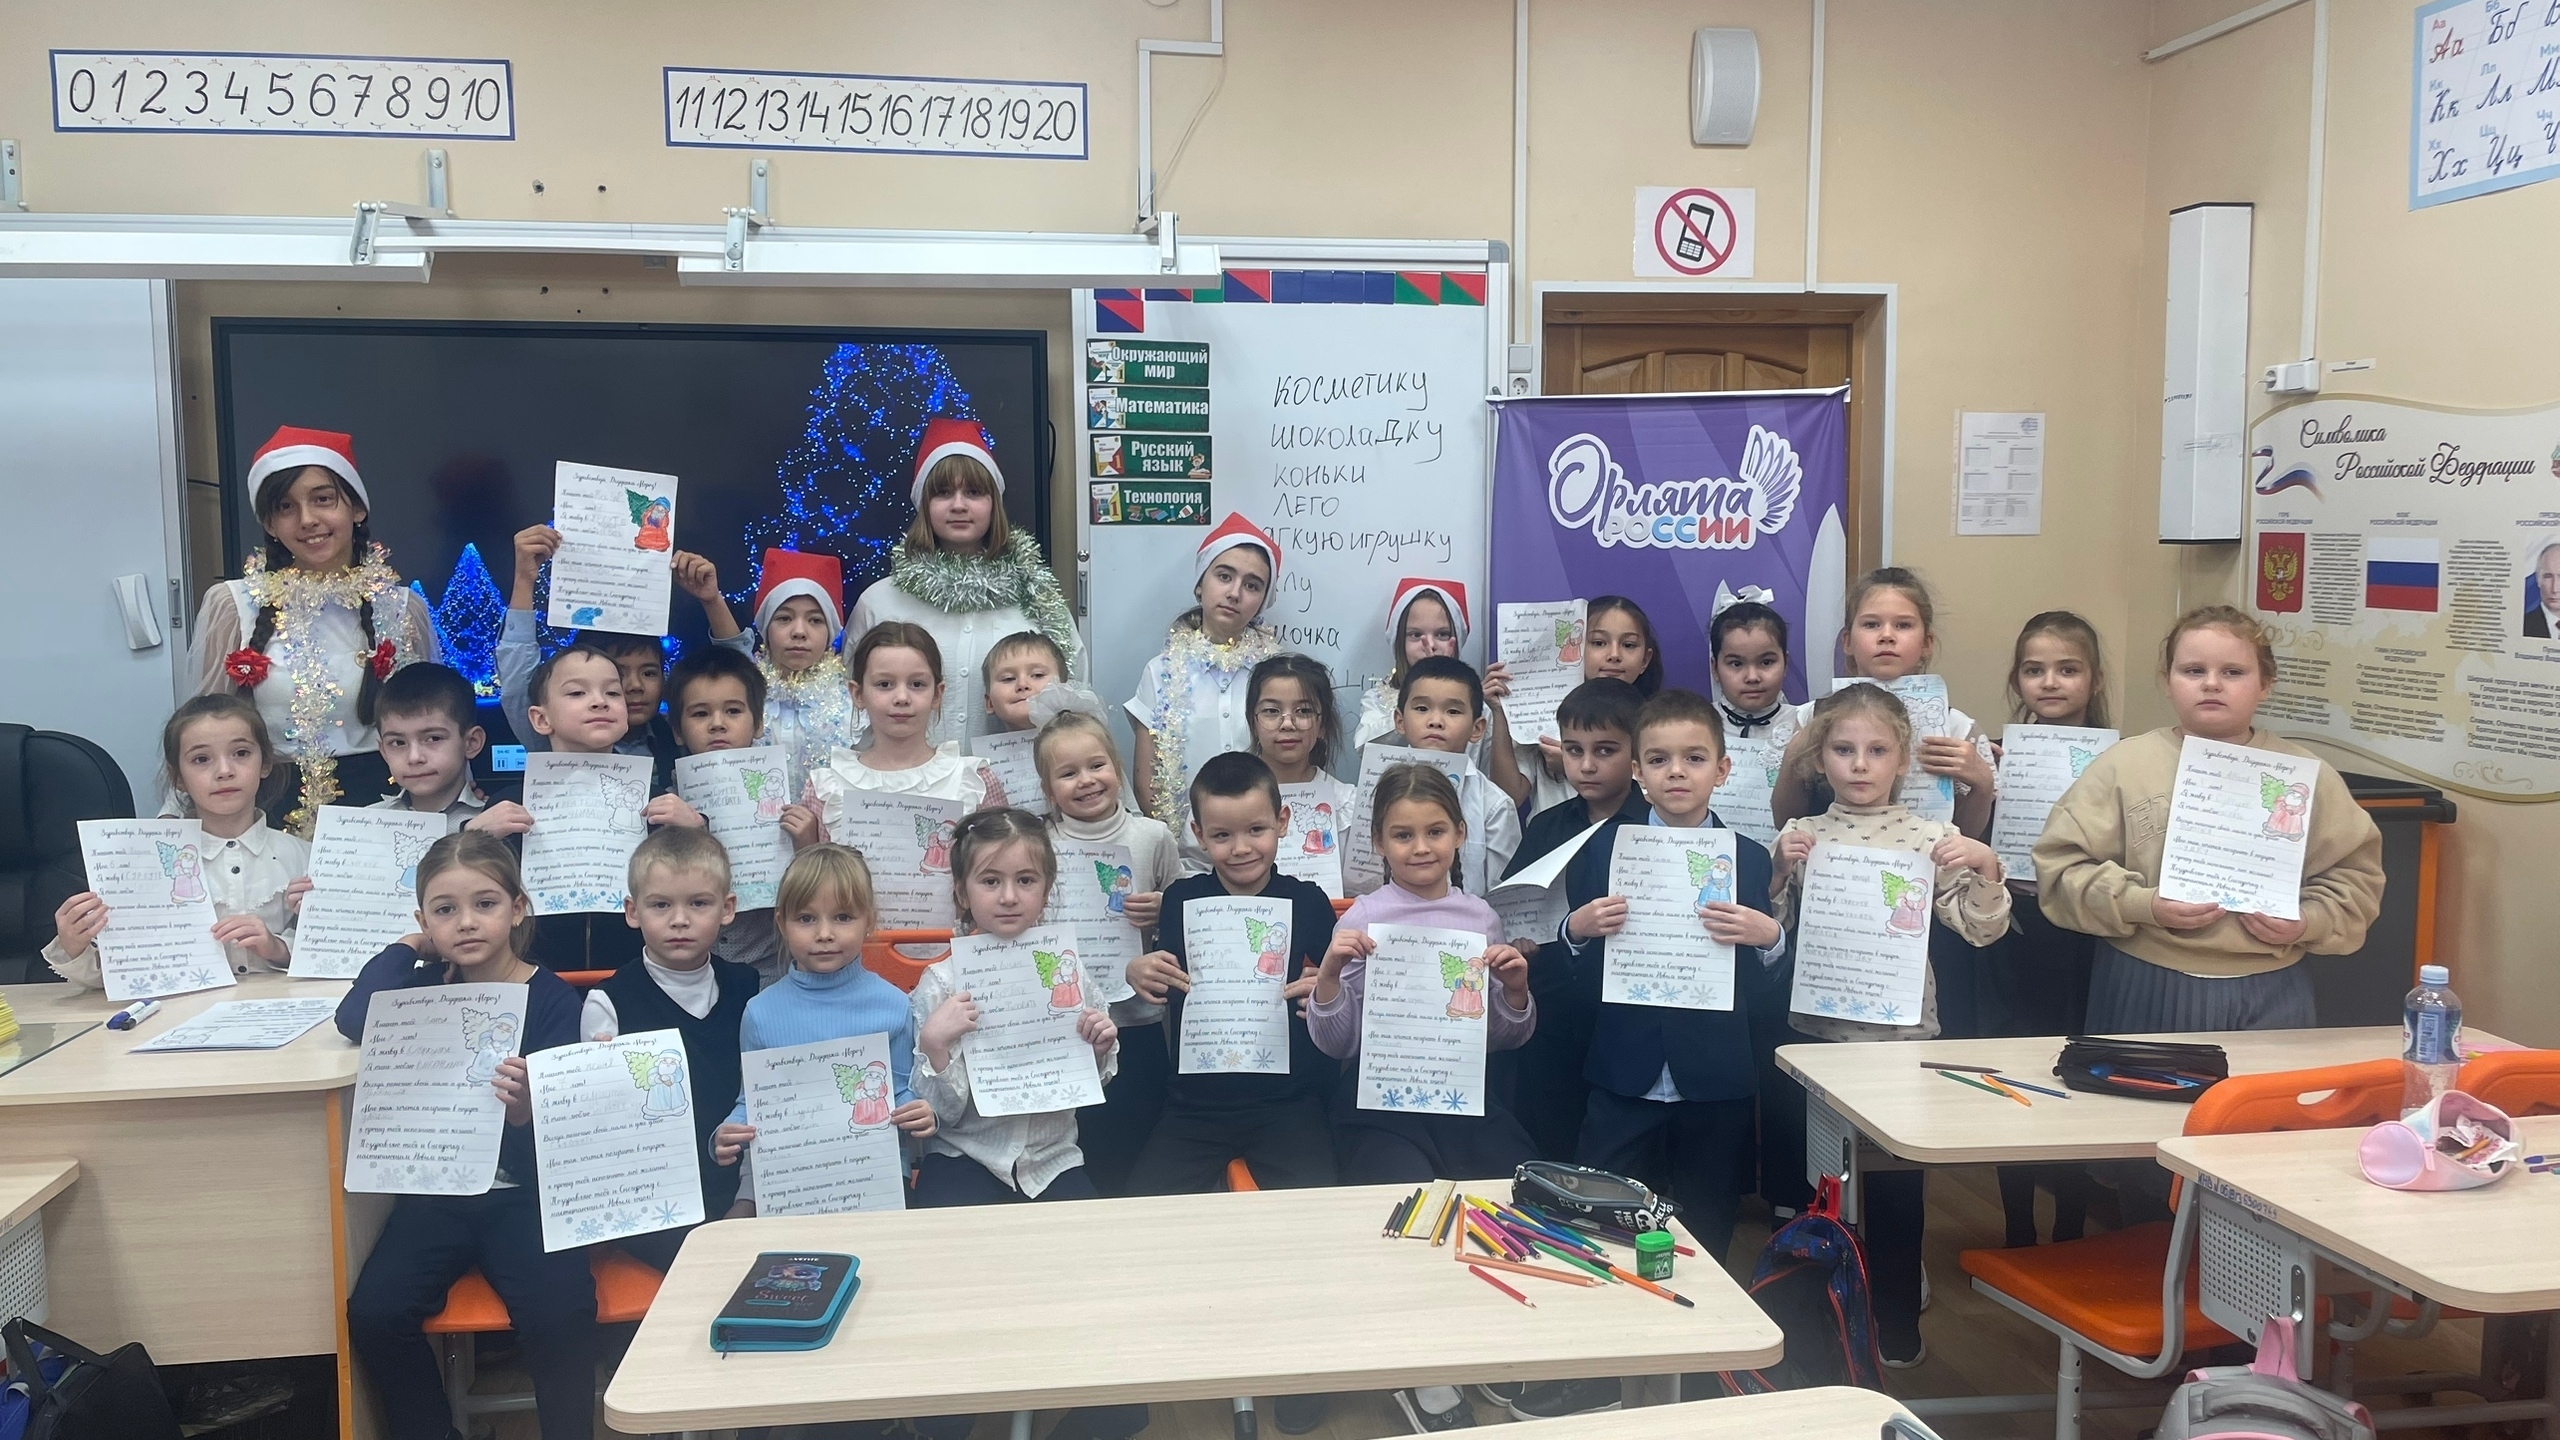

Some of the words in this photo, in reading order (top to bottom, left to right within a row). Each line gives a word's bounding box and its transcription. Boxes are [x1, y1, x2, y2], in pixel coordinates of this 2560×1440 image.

[1111, 346, 1208, 365] Окружающий
[1116, 398, 1209, 415] Математика
[2300, 414, 2388, 449] Символика
[1131, 441, 1194, 458] Русский
[2334, 451, 2426, 481] Российской
[2429, 442, 2536, 487] Федерации
[1124, 490, 1203, 504] Технология
[1554, 439, 1754, 532] Орлята
[1603, 515, 1750, 544] РОССИИ
